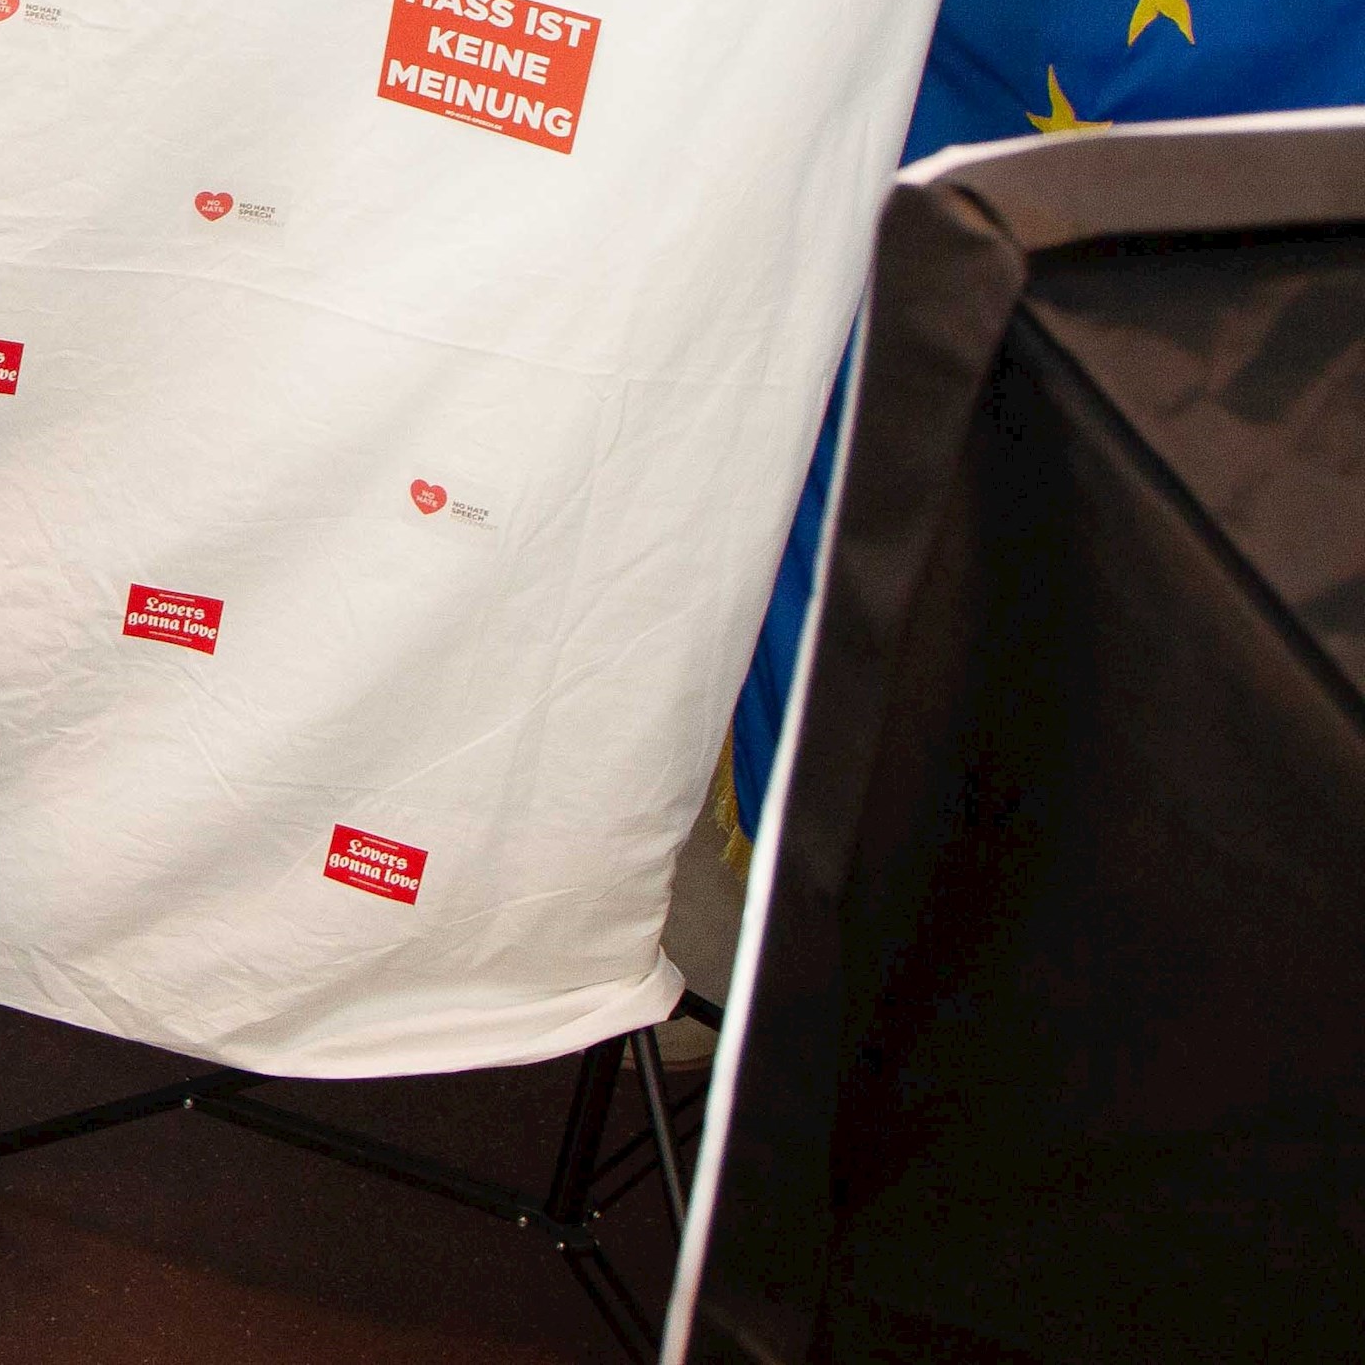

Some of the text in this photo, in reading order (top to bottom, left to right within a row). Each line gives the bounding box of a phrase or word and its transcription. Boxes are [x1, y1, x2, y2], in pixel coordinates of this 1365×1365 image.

[25, 11, 57, 21] SPEECH
[40, 6, 61, 16] HATE
[525, 7, 591, 47] IST
[427, 26, 551, 84] KEINE
[386, 59, 573, 138] MEINUNG
[239, 209, 271, 218] SPEECH
[254, 204, 276, 213] HATE
[452, 501, 489, 516] NO HATE
[452, 508, 484, 521] SPEECH
[144, 597, 205, 620] Lovers
[128, 612, 180, 630] gonna
[183, 619, 216, 639] love
[347, 839, 408, 870] Lovers
[329, 853, 381, 879] gonna
[384, 868, 419, 890] love
